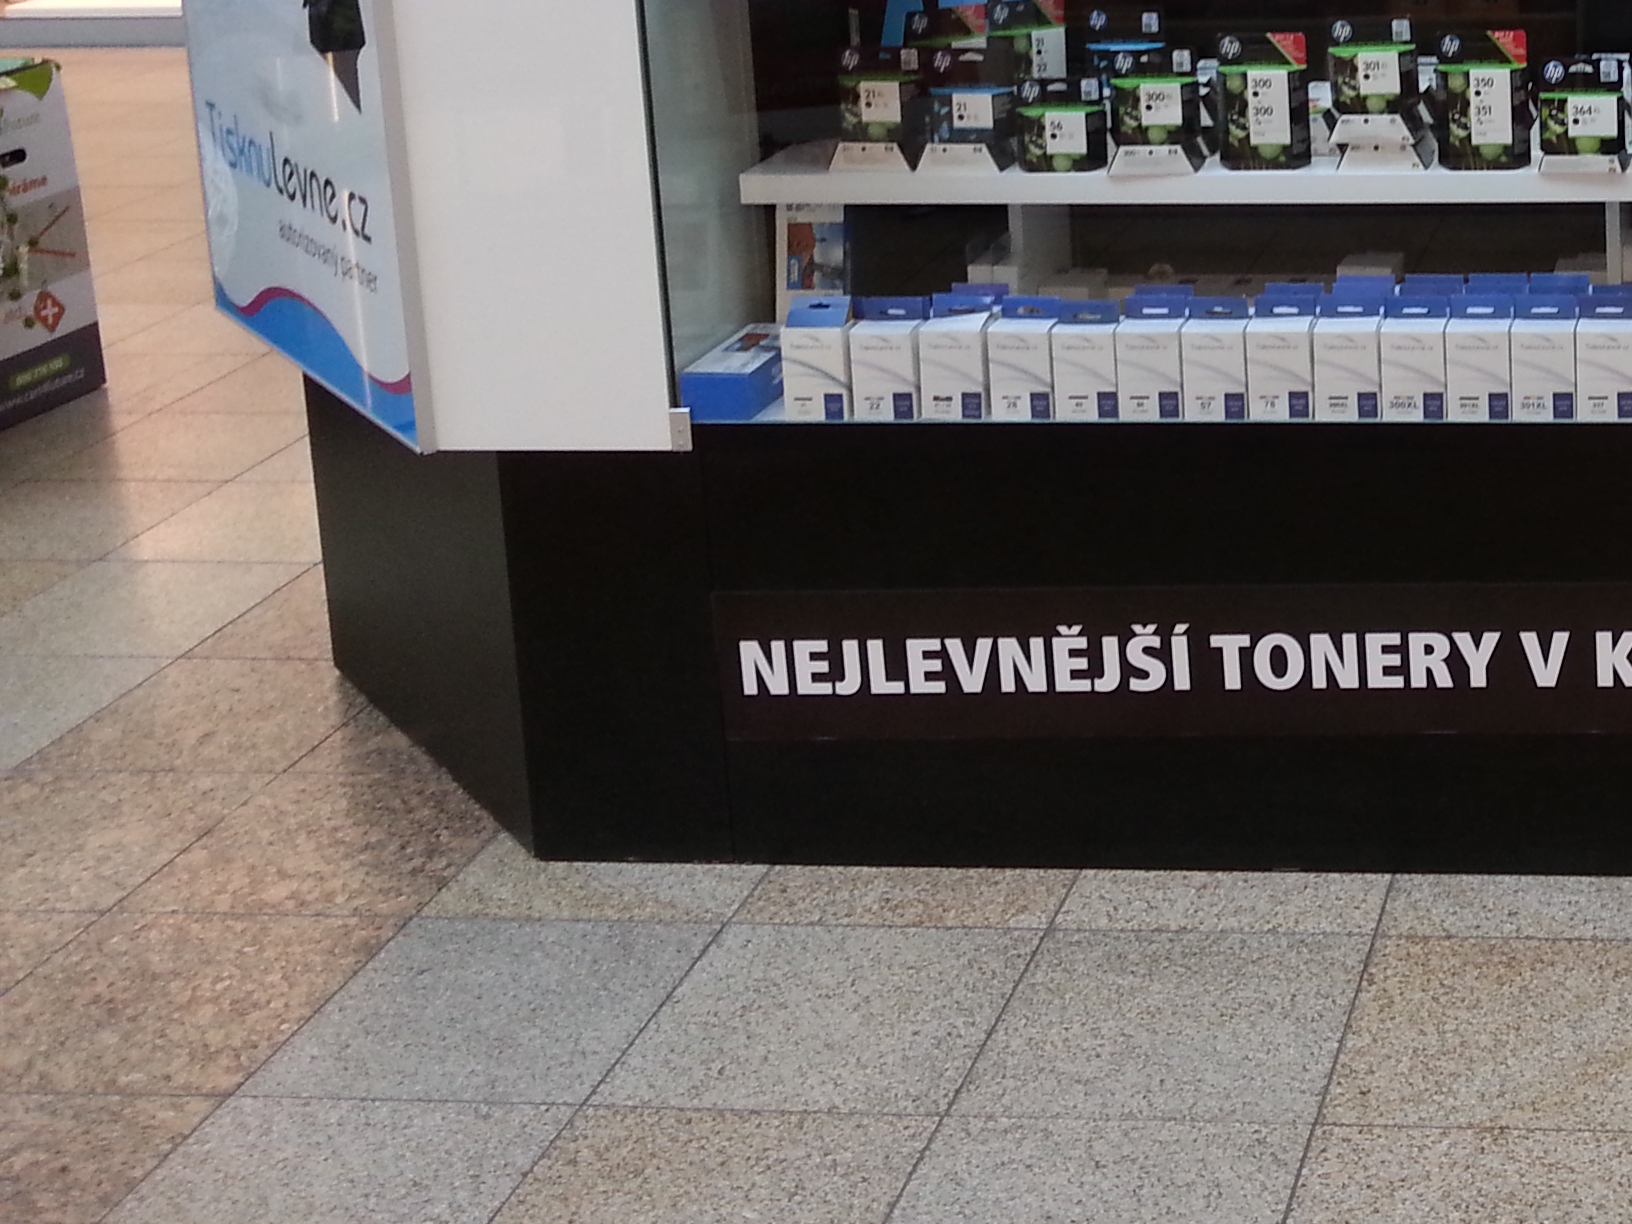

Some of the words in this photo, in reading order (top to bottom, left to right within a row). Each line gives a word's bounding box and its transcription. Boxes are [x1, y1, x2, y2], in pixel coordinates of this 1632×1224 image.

[1362, 60, 1381, 72] 301
[1251, 78, 1272, 90] 300
[1473, 77, 1494, 90] 350
[955, 102, 968, 113] 21
[1252, 106, 1274, 117] 300
[1473, 105, 1493, 117] 351
[1571, 104, 1593, 117] 364
[204, 99, 373, 246] TisknuLevne.cz
[738, 622, 1191, 697] NEJLEVNĚJŠÍ
[1209, 630, 1501, 692] TONERY
[1517, 631, 1570, 689] V
